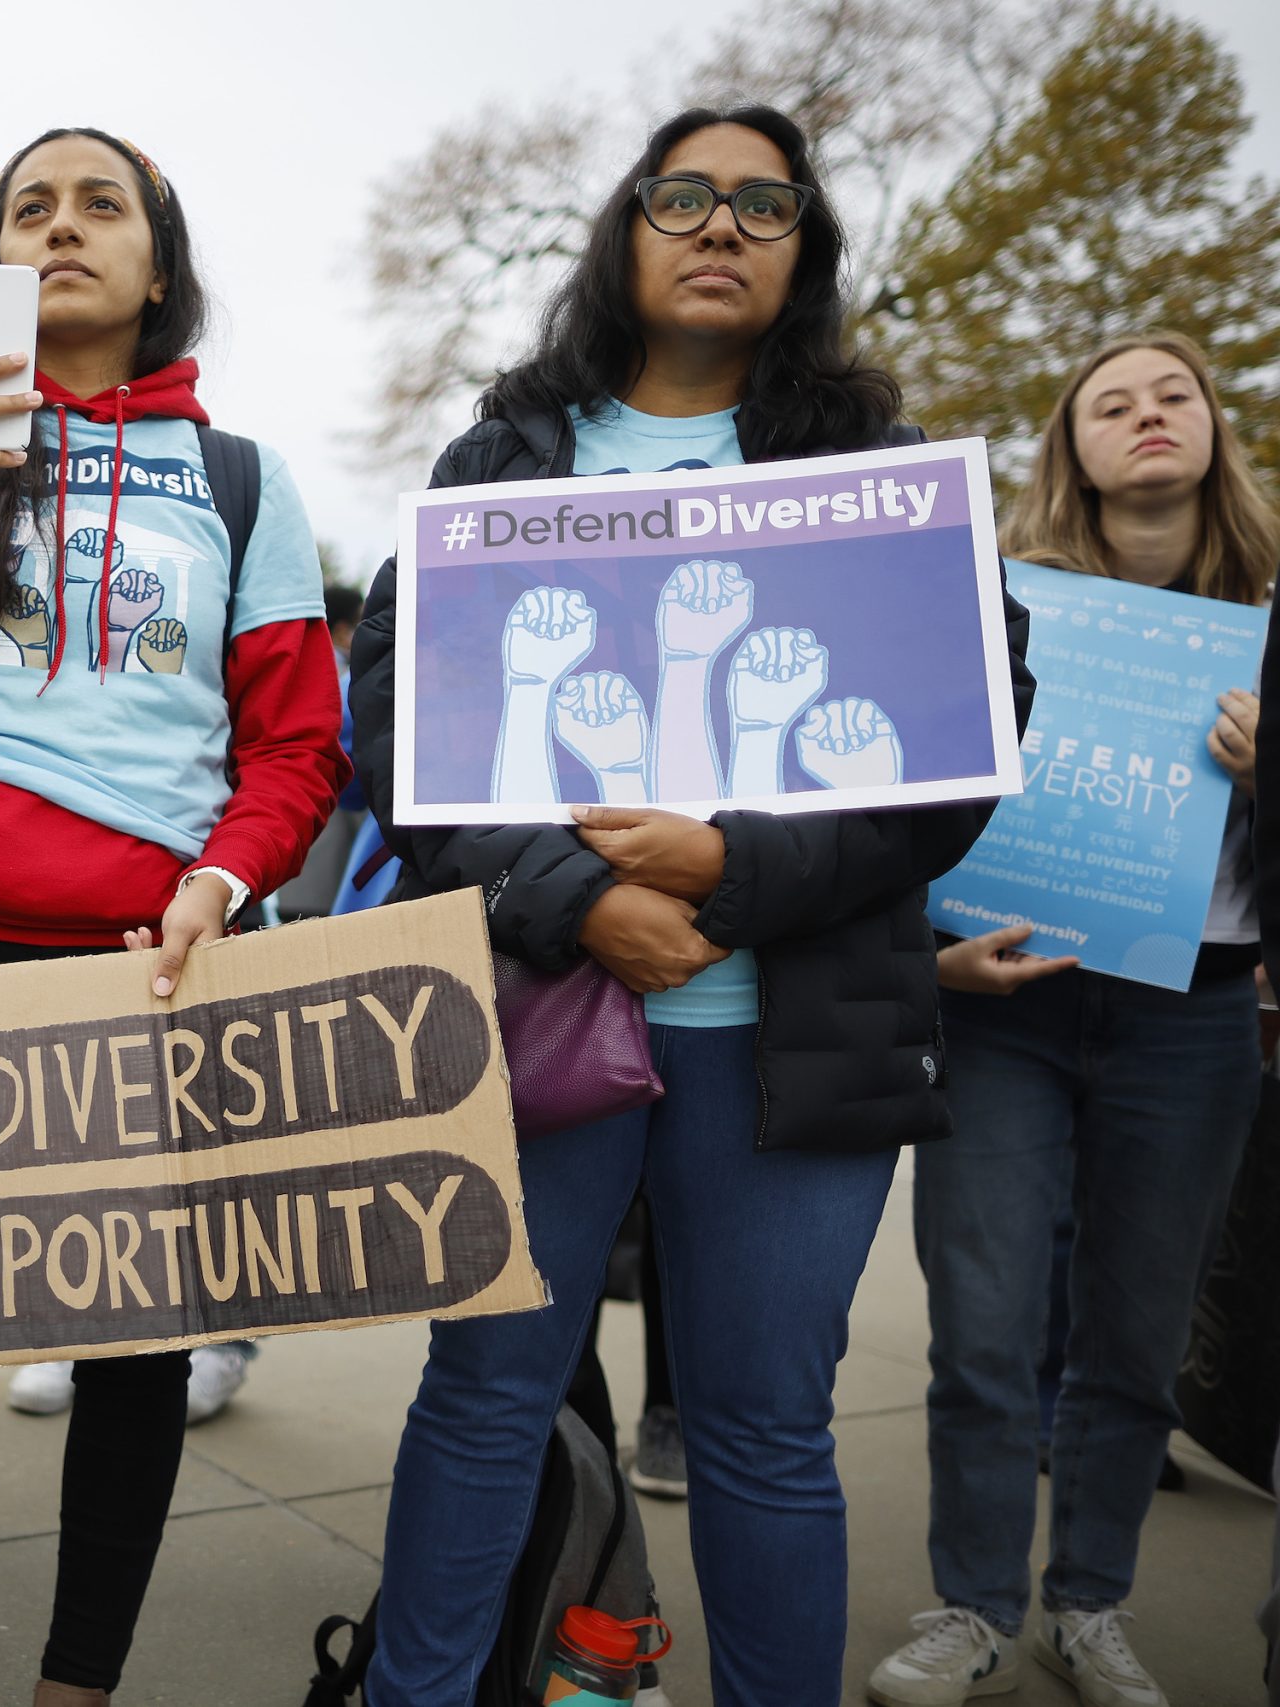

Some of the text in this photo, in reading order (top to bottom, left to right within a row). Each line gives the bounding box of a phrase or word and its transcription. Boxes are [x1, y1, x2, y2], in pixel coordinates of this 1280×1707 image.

[442, 478, 940, 551] #DefendDiversity
[1097, 693, 1204, 726] DIVERSIDADE
[1020, 729, 1192, 788] EFEND
[1019, 757, 1189, 820] VERSITY
[960, 861, 1049, 890] EFENDEMOS
[1074, 885, 1165, 915] DIVERSIDAD
[1086, 851, 1172, 881] DIVERSITY
